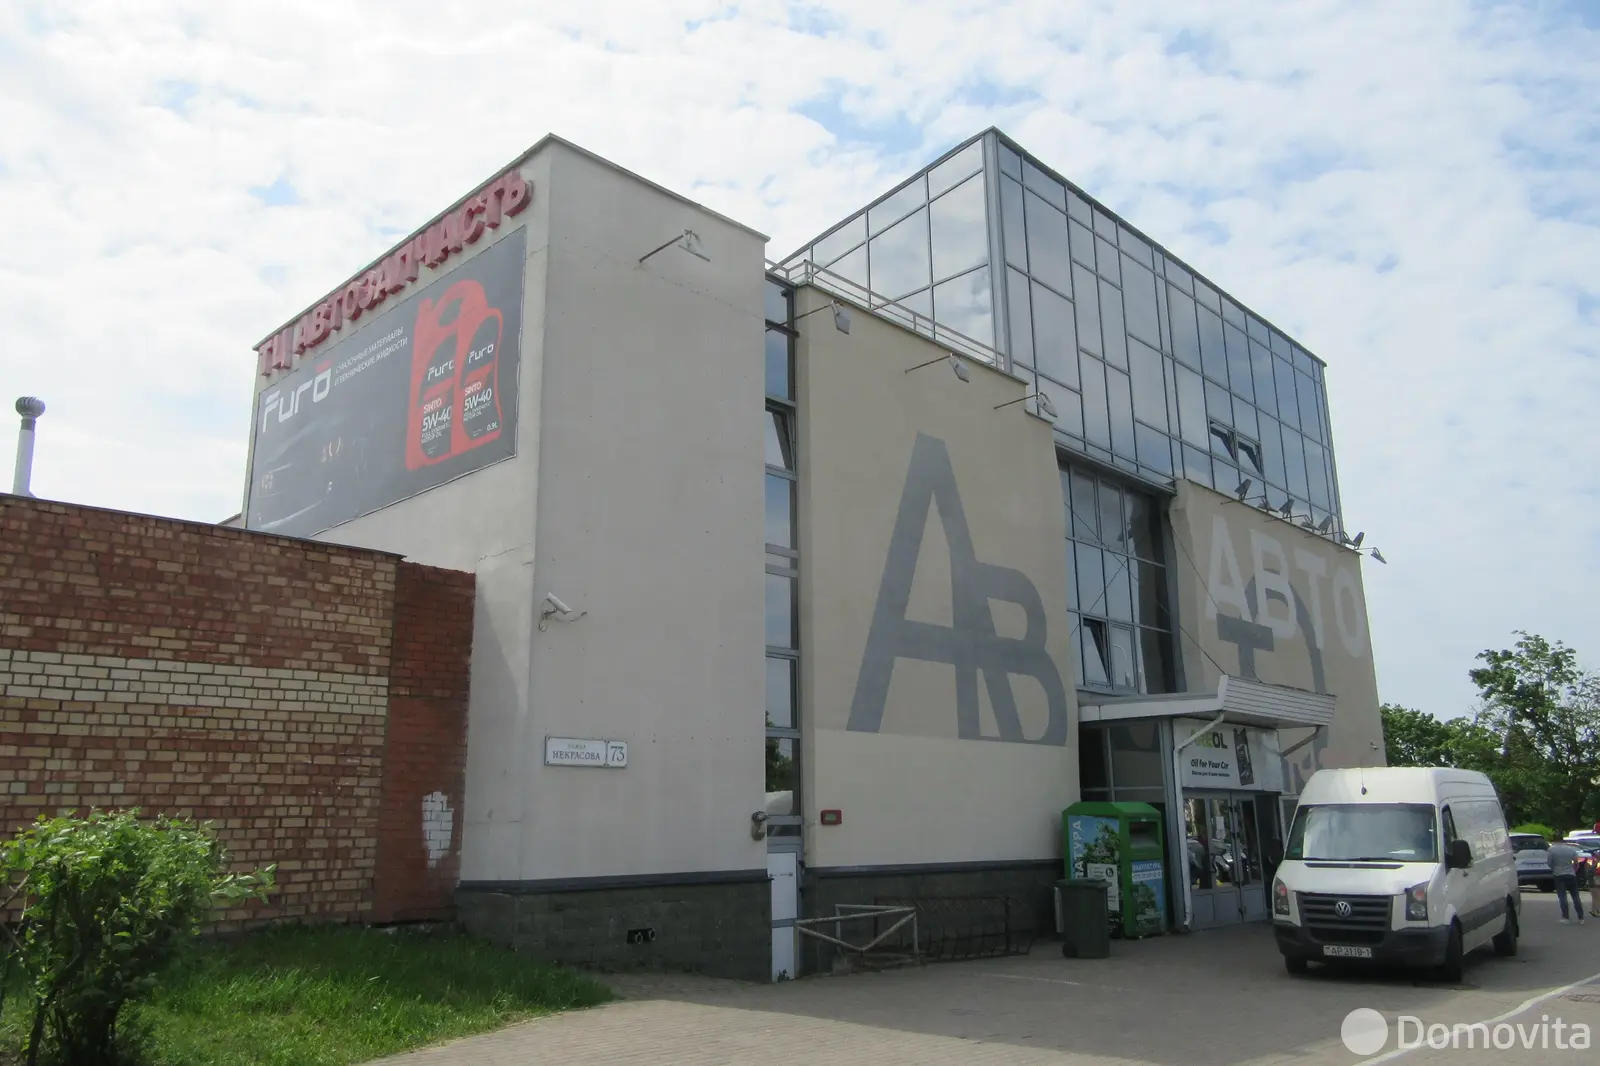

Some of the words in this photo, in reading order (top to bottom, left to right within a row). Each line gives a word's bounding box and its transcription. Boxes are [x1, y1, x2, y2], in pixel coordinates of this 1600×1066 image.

[259, 327, 292, 376] ТЦ
[294, 169, 533, 355] АВТОЗАПЧАСТЬ
[368, 326, 404, 352] МАТЕРИАЛЫ
[376, 337, 408, 361] ЖИДКОСТИ
[464, 381, 482, 396] SINTO
[464, 387, 492, 412] 5W-40
[423, 397, 442, 415] SINTO
[422, 405, 452, 432] 5W-40
[1205, 512, 1367, 659] АВТО
[552, 750, 601, 761] НЕКРАСОВА
[610, 746, 625, 762] 73
[1191, 758, 1199, 768] Oil
[1207, 760, 1220, 769] Your
[1220, 761, 1230, 770] Car
